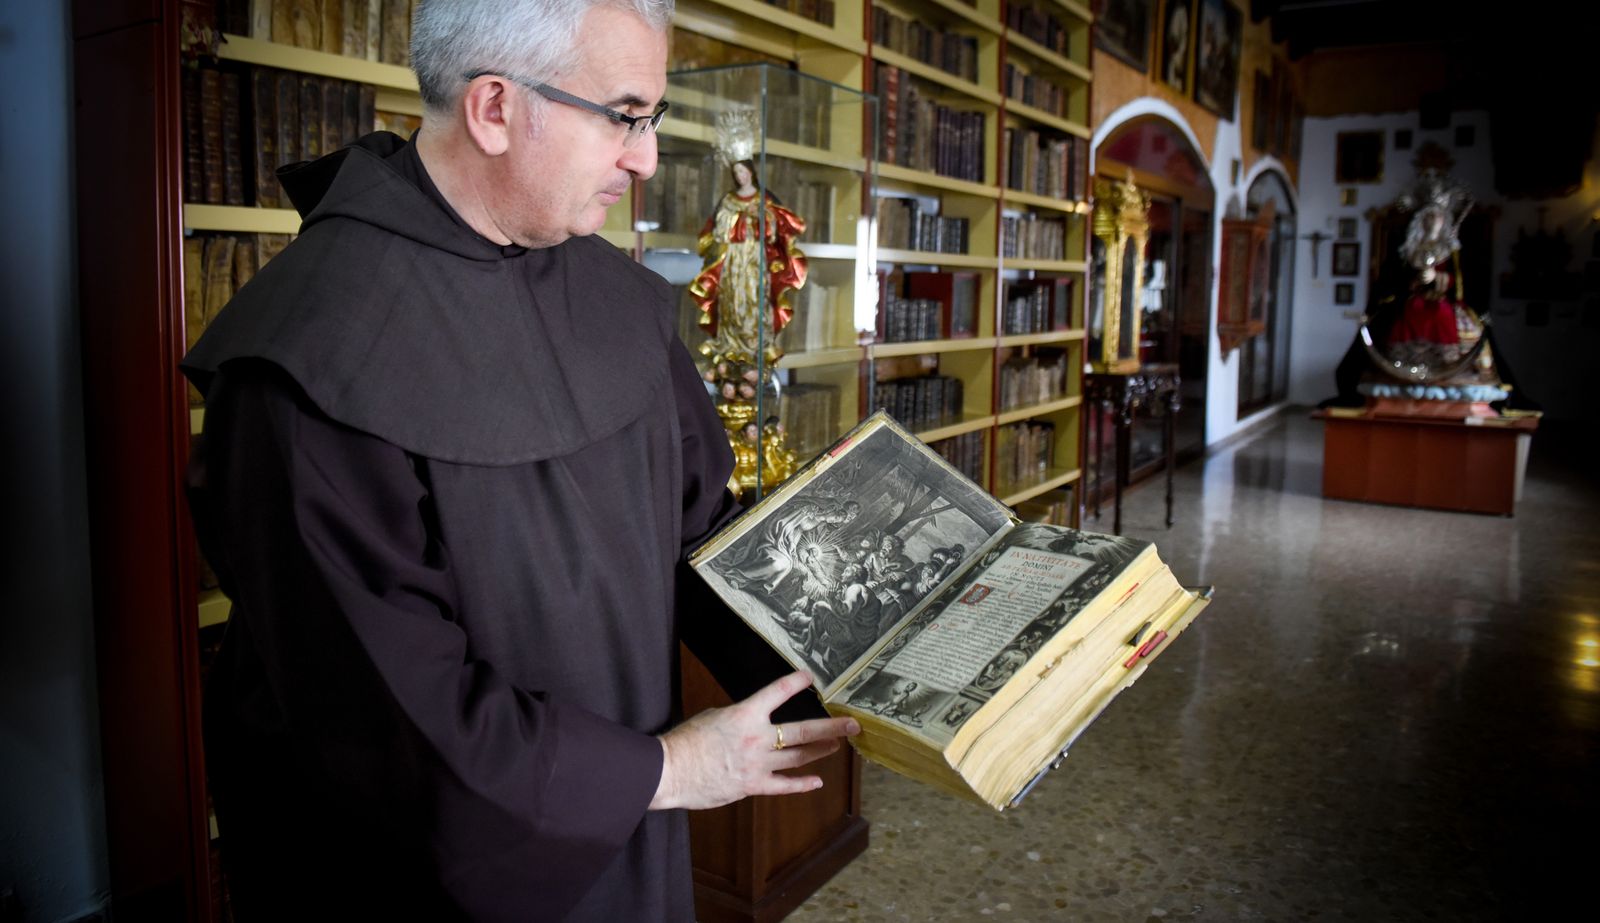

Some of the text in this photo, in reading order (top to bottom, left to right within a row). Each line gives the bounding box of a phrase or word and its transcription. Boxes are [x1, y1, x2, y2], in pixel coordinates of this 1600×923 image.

[1010, 551, 1080, 569] IN NATIVITATE
[1022, 561, 1054, 571] DOMINI
